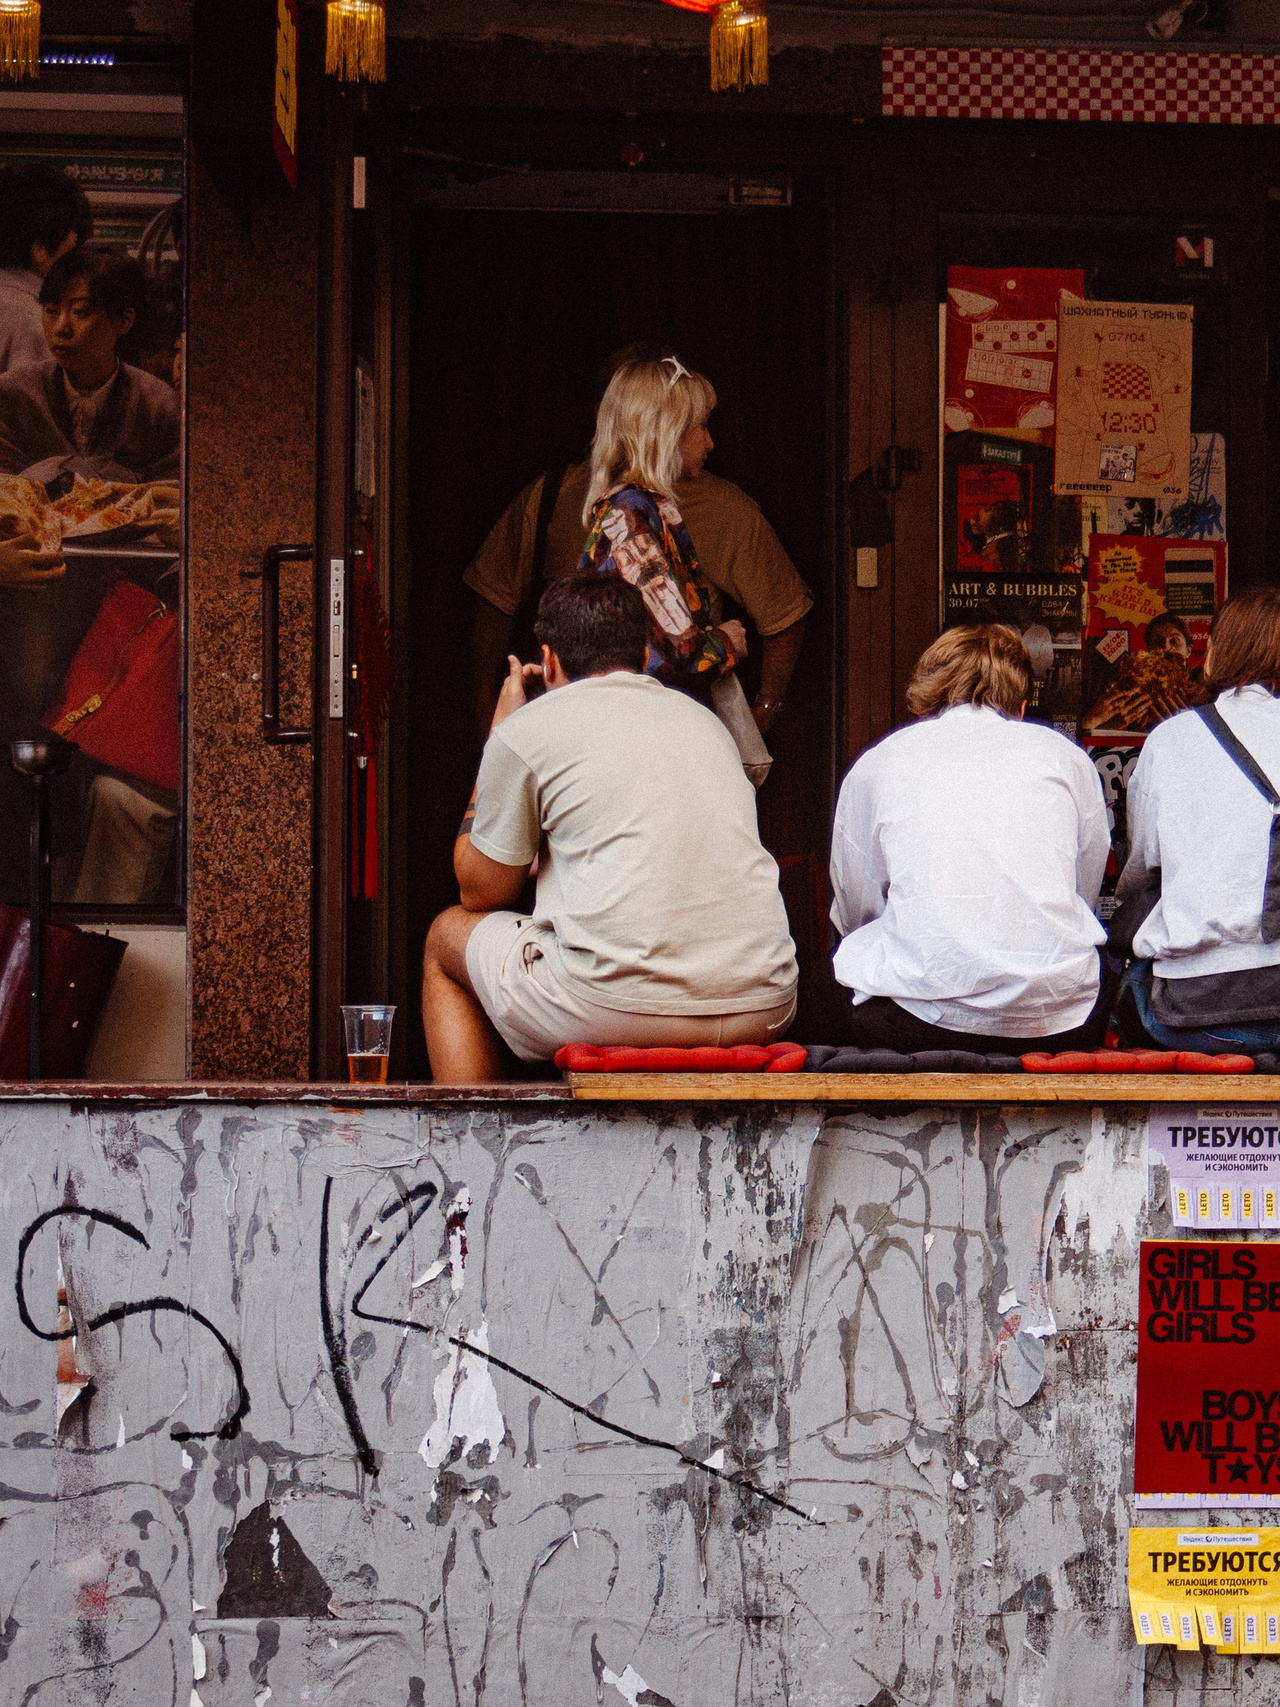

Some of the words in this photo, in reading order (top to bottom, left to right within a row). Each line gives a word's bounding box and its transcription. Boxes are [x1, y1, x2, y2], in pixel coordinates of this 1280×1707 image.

[1063, 306, 1137, 319] ШАХМАТНЫЙ
[1143, 309, 1187, 320] ТУРНИР
[1108, 332, 1144, 342] 07/04
[1101, 412, 1157, 434] 12:30
[949, 583, 981, 595] ART
[986, 582, 997, 596] &
[1003, 583, 1077, 596] BUBBLES
[1112, 589, 1151, 606] WORLD
[1100, 594, 1137, 610] KEBAB
[1139, 606, 1160, 617] DAY
[1187, 1153, 1237, 1162] ЖЕЛАЮЩИЕ
[1178, 1193, 1186, 1211] LETO
[1147, 1248, 1256, 1280] GIRLS
[1148, 1280, 1235, 1312] WILL
[1147, 1312, 1255, 1344] GIRLS
[1160, 1422, 1247, 1452] WILL
[1167, 1579, 1217, 1587] ЖЕЛАЮЩИЕ
[1219, 1578, 1267, 1587] ОТДОХНУТЬ
